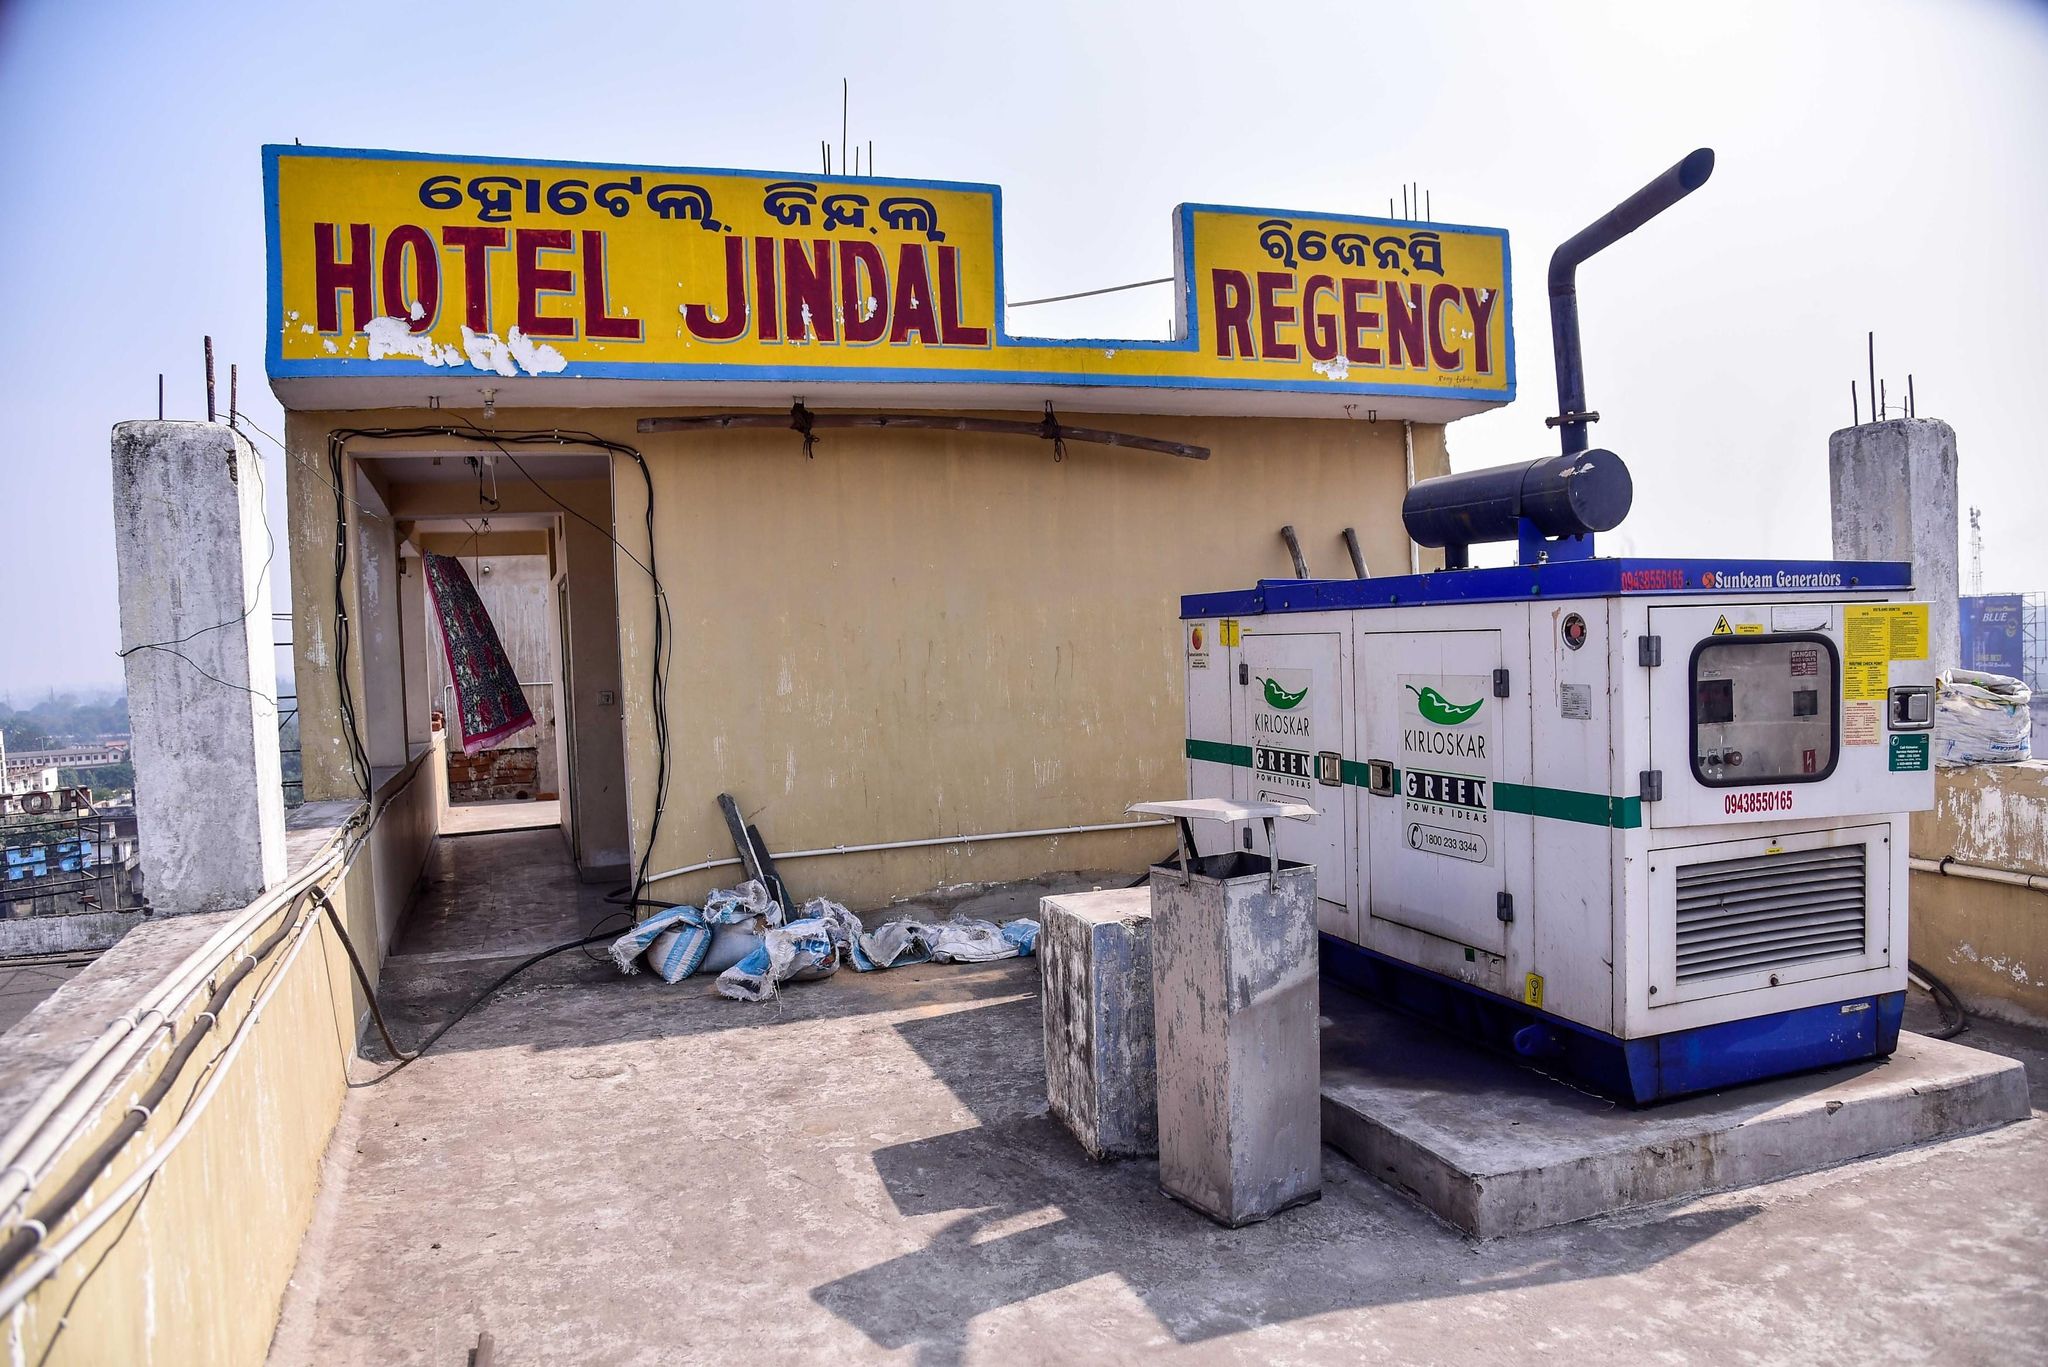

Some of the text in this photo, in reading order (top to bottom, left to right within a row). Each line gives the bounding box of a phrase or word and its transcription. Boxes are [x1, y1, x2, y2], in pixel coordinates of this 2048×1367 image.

[314, 222, 1498, 374] HOTEL JINDAL REGENCY
[1621, 569, 1684, 592] 09438550165
[1715, 570, 1841, 589] Sunbeam Generators
[1982, 612, 2008, 622] BLUE
[1255, 713, 1310, 737] KIRLOSKAR
[1404, 729, 1486, 759] KIRLOSKAR
[1256, 749, 1311, 776] GREEN
[1256, 773, 1311, 790] POWER IDEAS
[1406, 772, 1487, 806] GREEN
[1406, 802, 1487, 823] POWER IDEAS
[1725, 790, 1793, 814] 09438550165
[1425, 833, 1478, 853] 1800 233 3344
